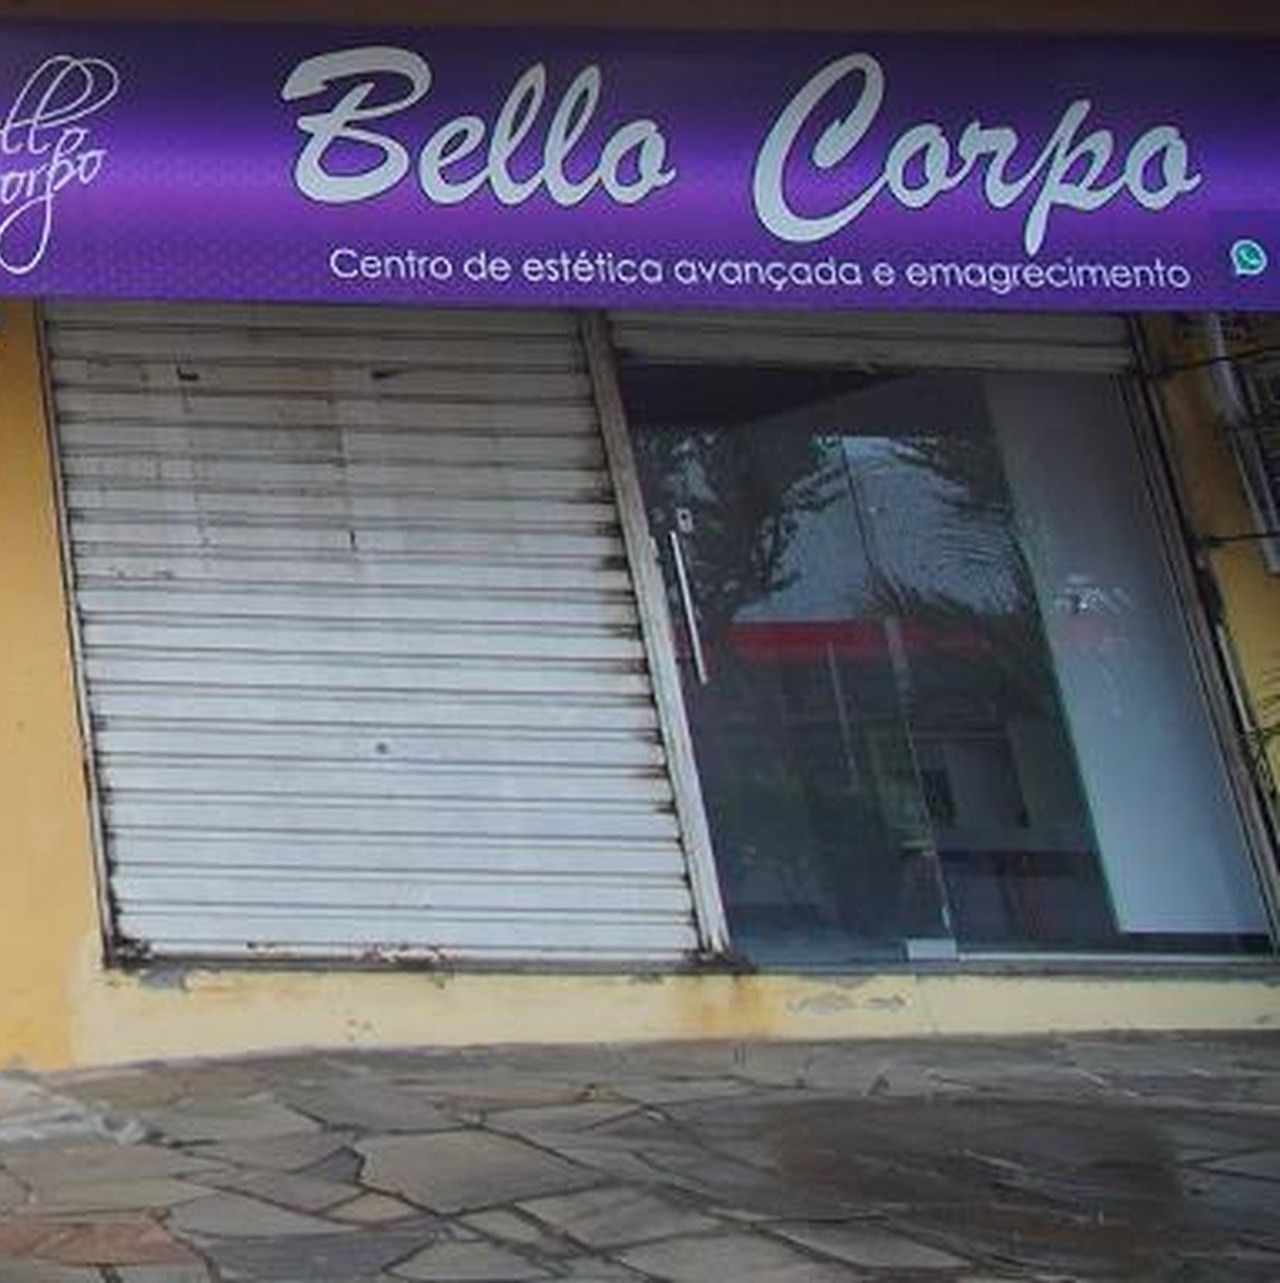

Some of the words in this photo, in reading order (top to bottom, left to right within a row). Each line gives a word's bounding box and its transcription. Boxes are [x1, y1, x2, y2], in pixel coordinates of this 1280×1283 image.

[281, 44, 676, 207] Bello
[751, 52, 1203, 257] Corpo
[329, 247, 454, 280] Centro
[463, 248, 511, 281] de
[523, 249, 664, 285] estética
[674, 253, 863, 291] avançada
[874, 264, 896, 286] e
[906, 257, 1192, 294] emagrecimento
